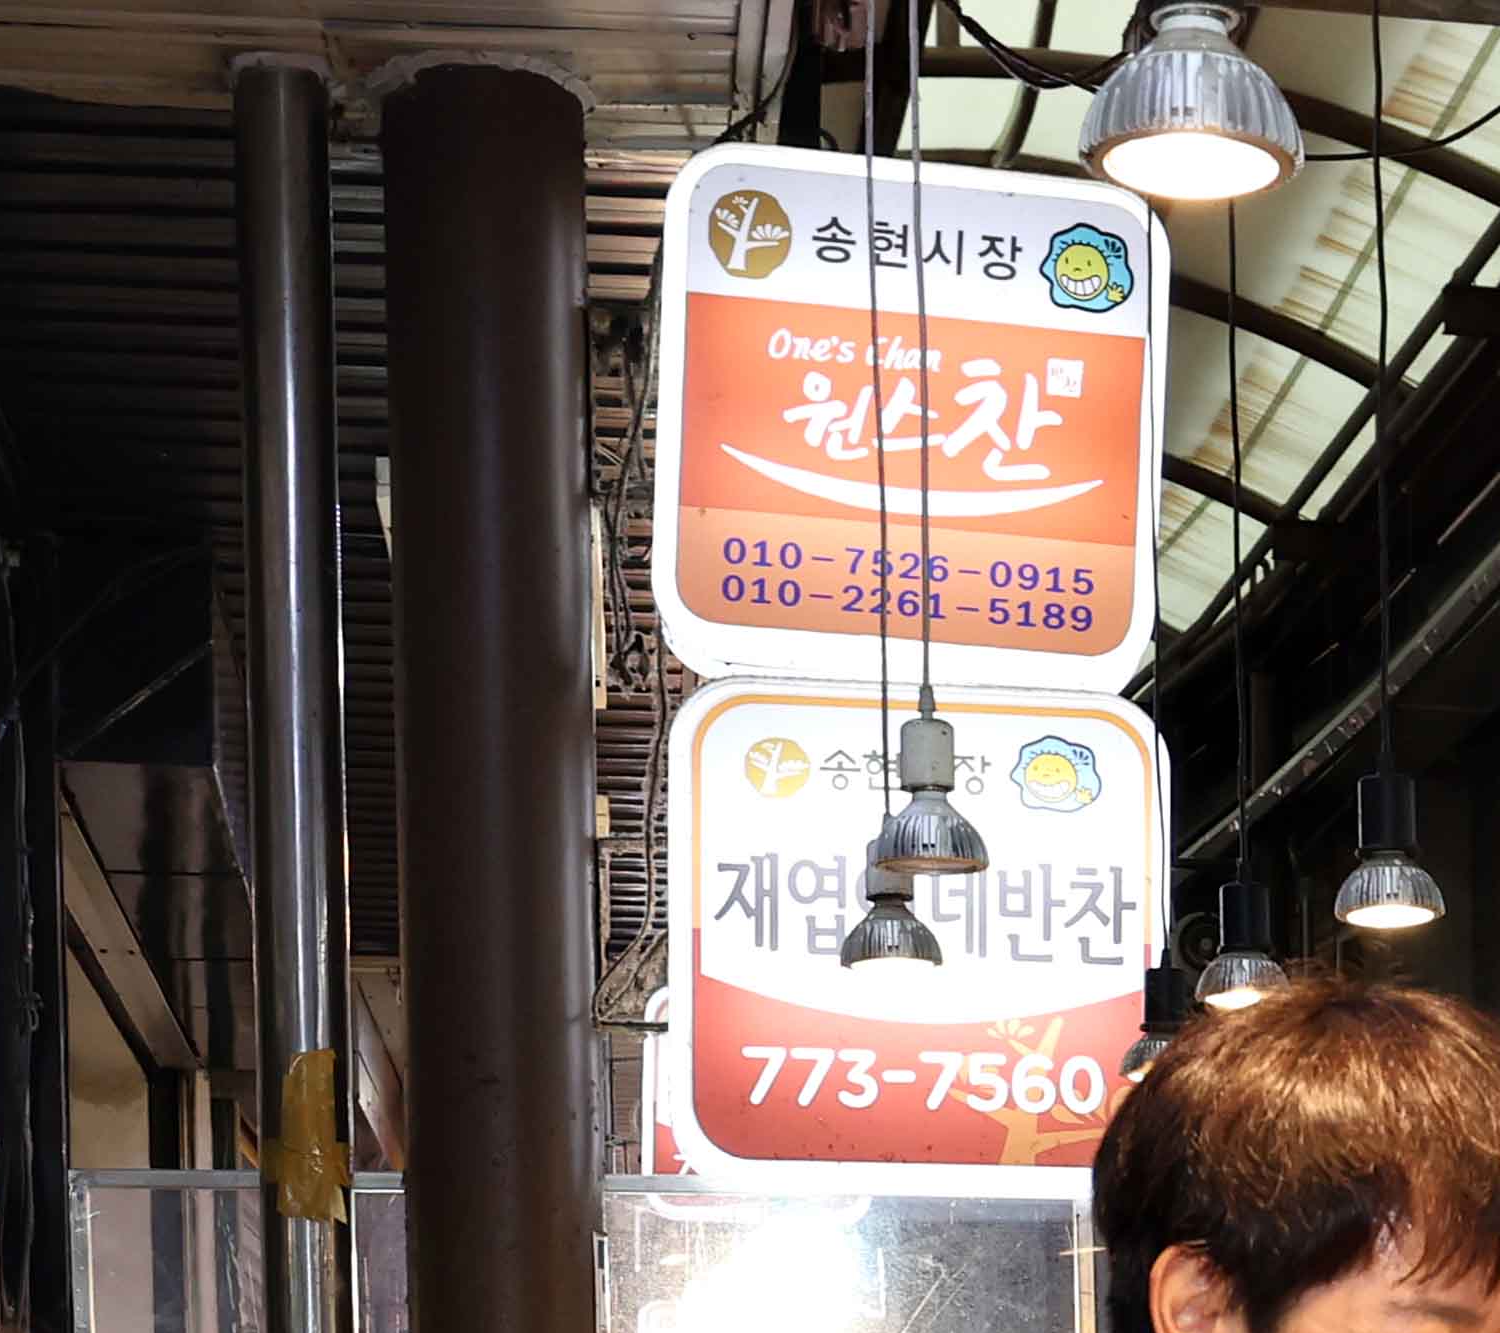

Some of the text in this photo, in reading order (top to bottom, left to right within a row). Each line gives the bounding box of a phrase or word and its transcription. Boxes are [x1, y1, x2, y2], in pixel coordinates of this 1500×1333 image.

[811, 216, 1023, 281] 송현시장
[767, 327, 942, 371] One's Chan
[783, 358, 1063, 481] 원스찬
[723, 536, 1095, 598] 010-7526-0915
[722, 573, 1095, 633] 010-2261-5189
[820, 750, 992, 795] 송현장
[714, 851, 1137, 965] 재엽네반찬
[740, 1047, 1105, 1115] 773-7560
